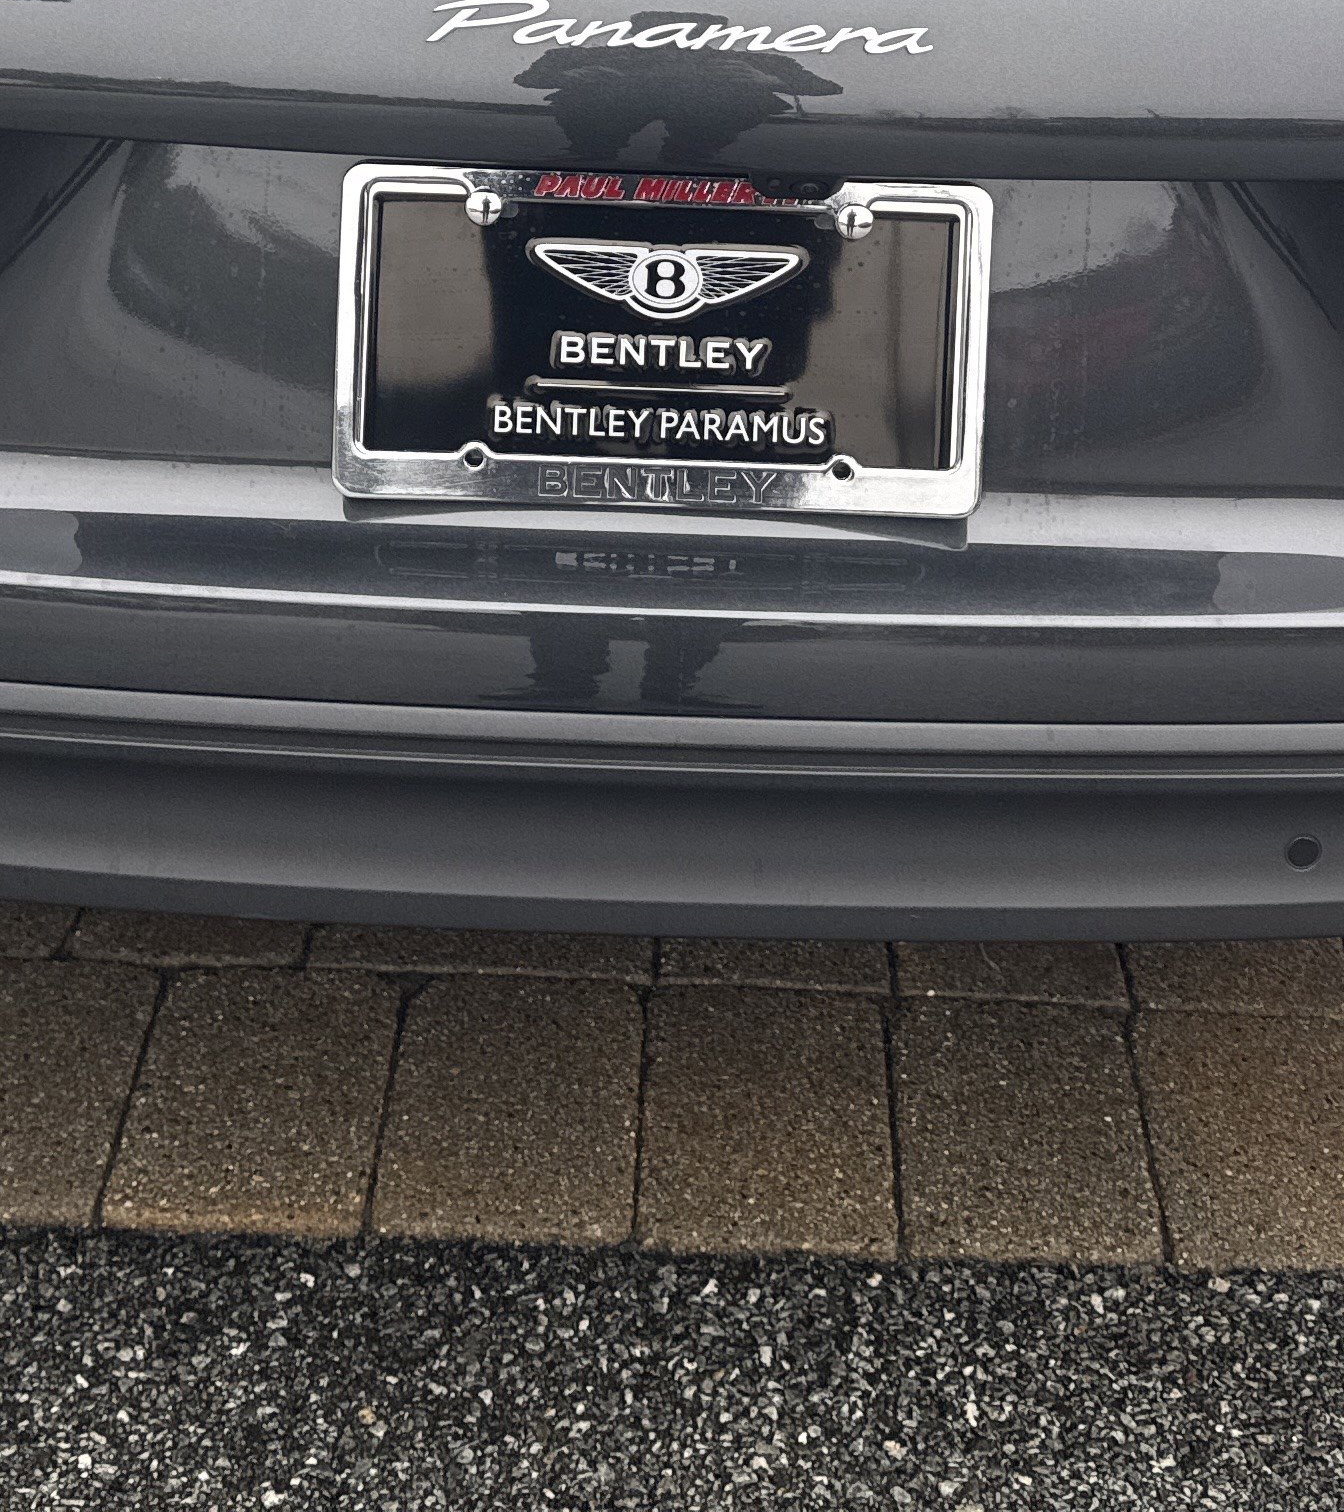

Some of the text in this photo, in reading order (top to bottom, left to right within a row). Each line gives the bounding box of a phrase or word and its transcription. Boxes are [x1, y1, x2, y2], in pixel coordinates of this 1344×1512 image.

[534, 174, 756, 204] PAUL MILLER
[645, 259, 685, 299] B
[559, 335, 764, 370] BENTLEY
[493, 405, 826, 445] BENTLEY PARAMUS
[537, 464, 778, 505] BENTLEY
